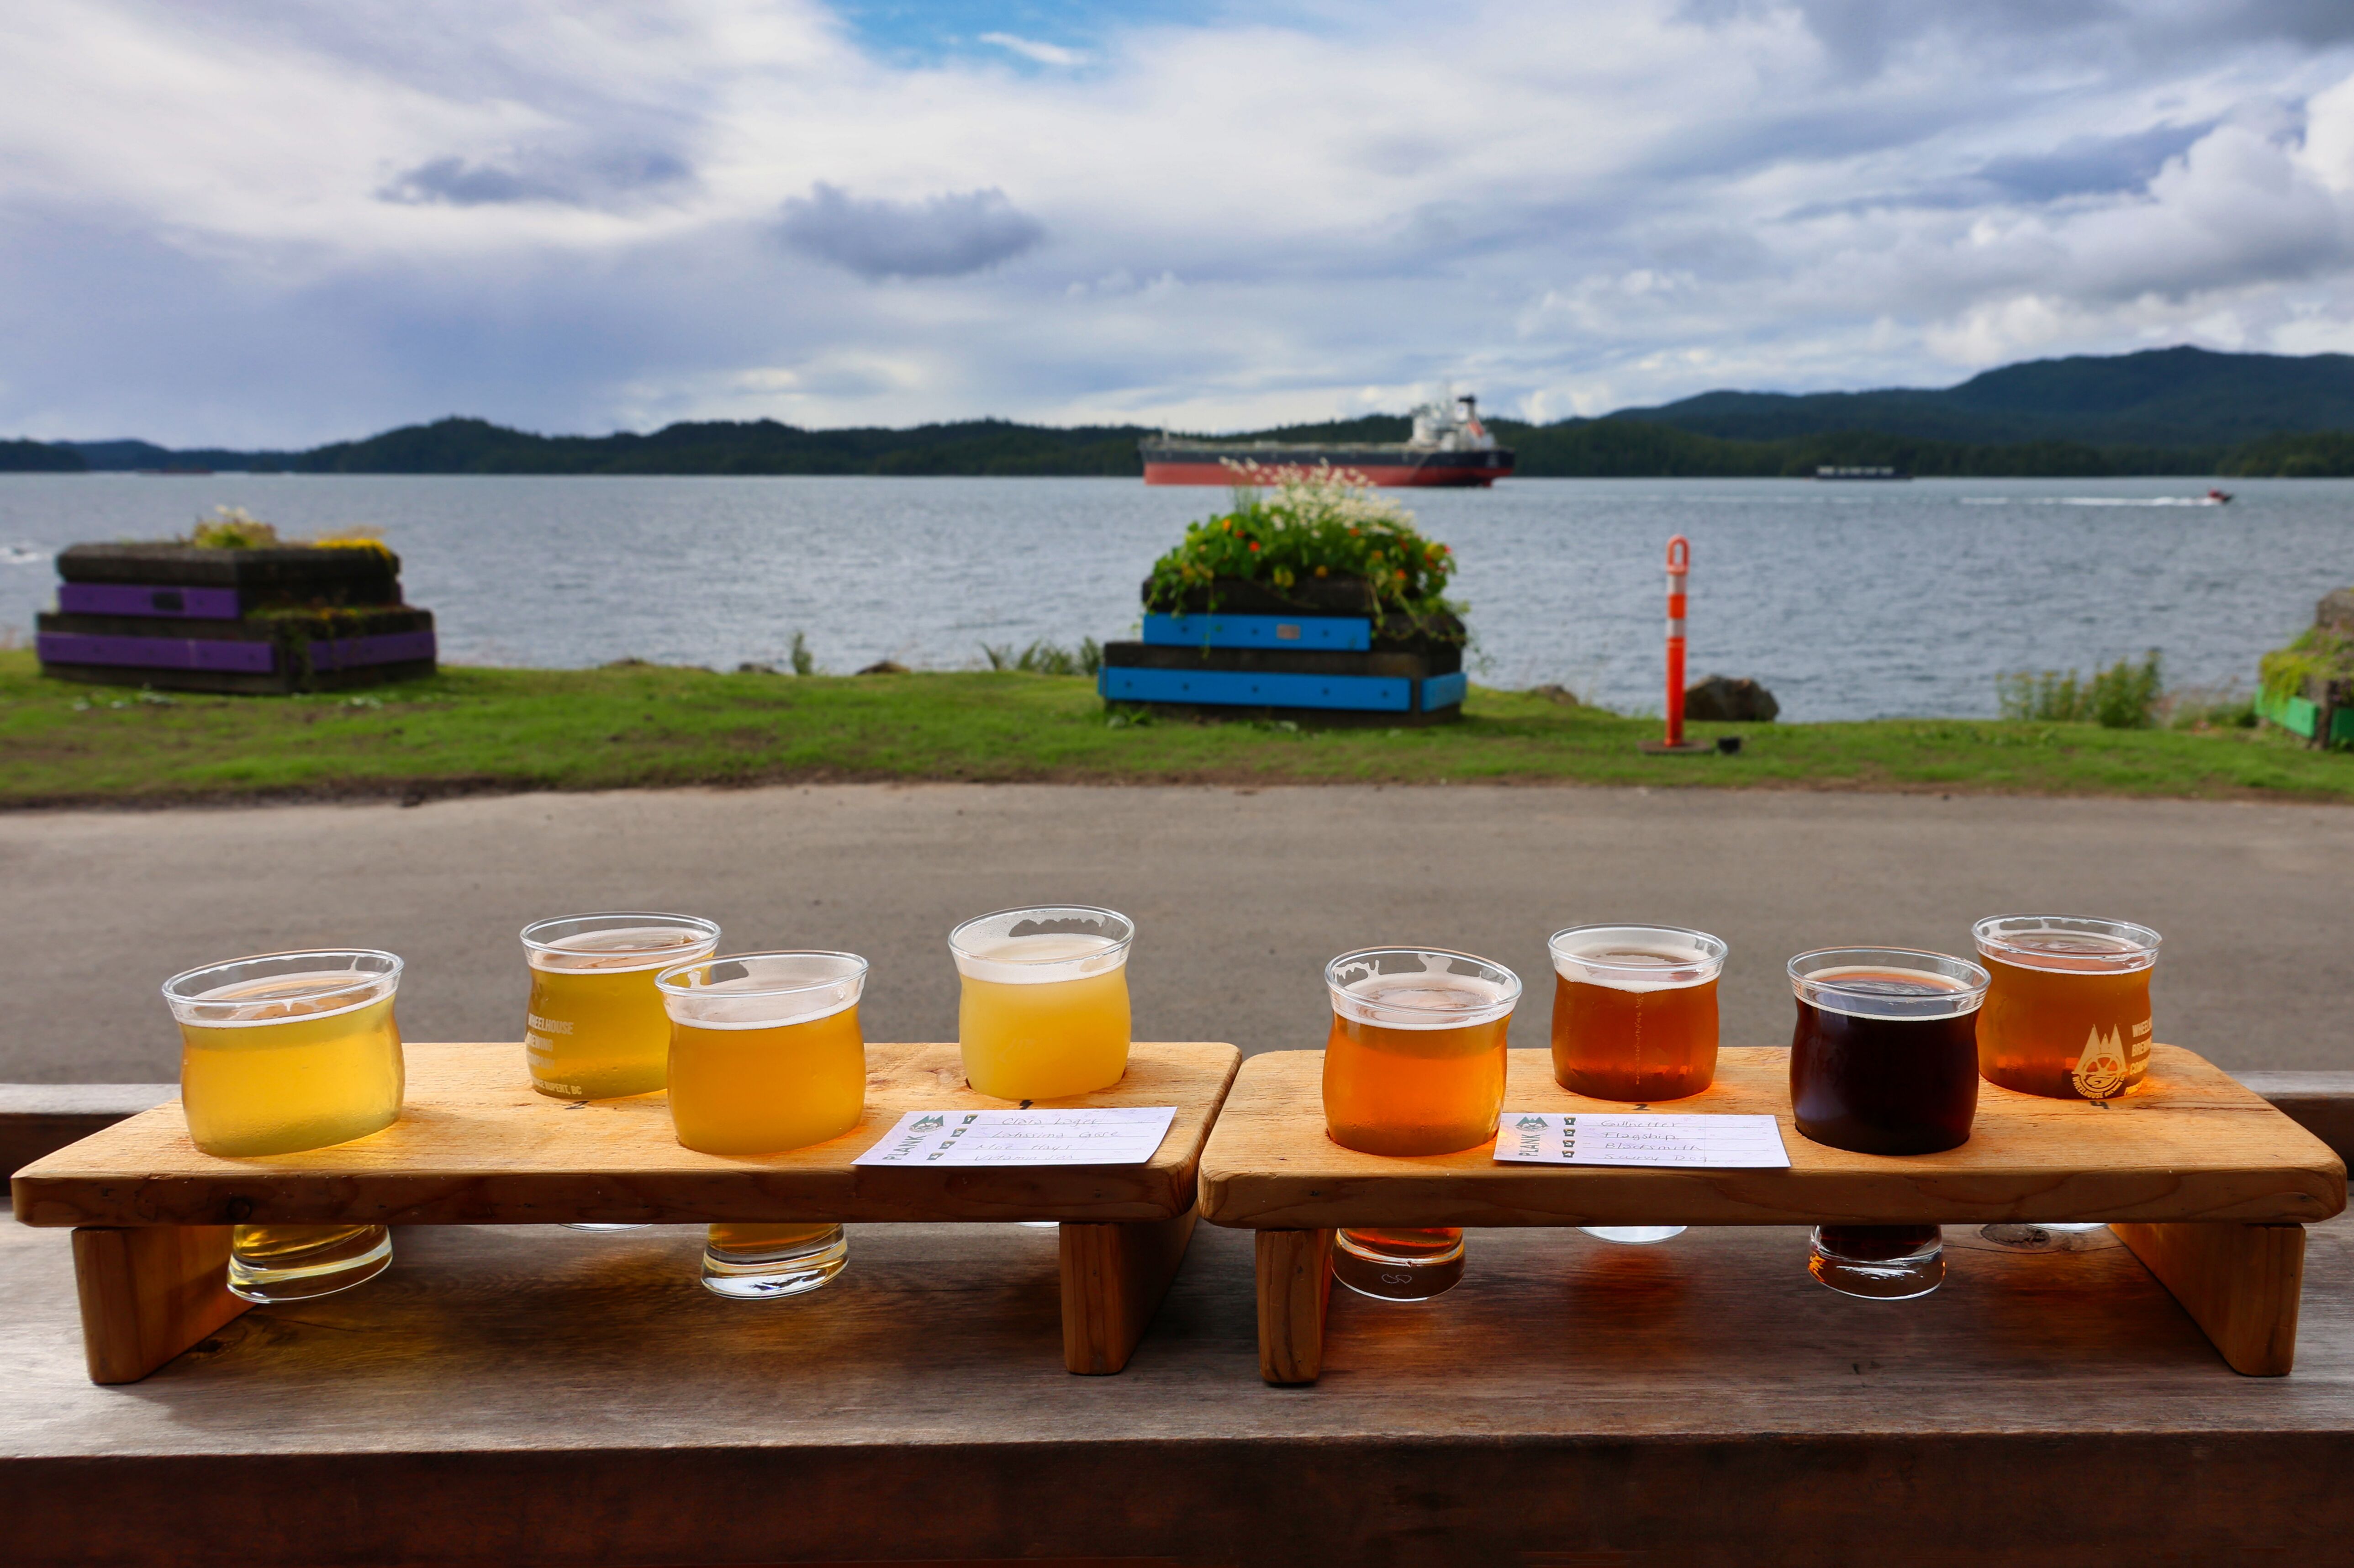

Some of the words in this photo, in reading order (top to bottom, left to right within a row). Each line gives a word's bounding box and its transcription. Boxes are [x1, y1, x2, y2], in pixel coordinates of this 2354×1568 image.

[571, 1086, 582, 1095] BC
[2072, 1076, 2104, 1098] WHEELHOUSE
[1519, 1134, 1541, 1156] PLANK
[1601, 1132, 1676, 1140] Flagship
[882, 1135, 927, 1160] PLANK
